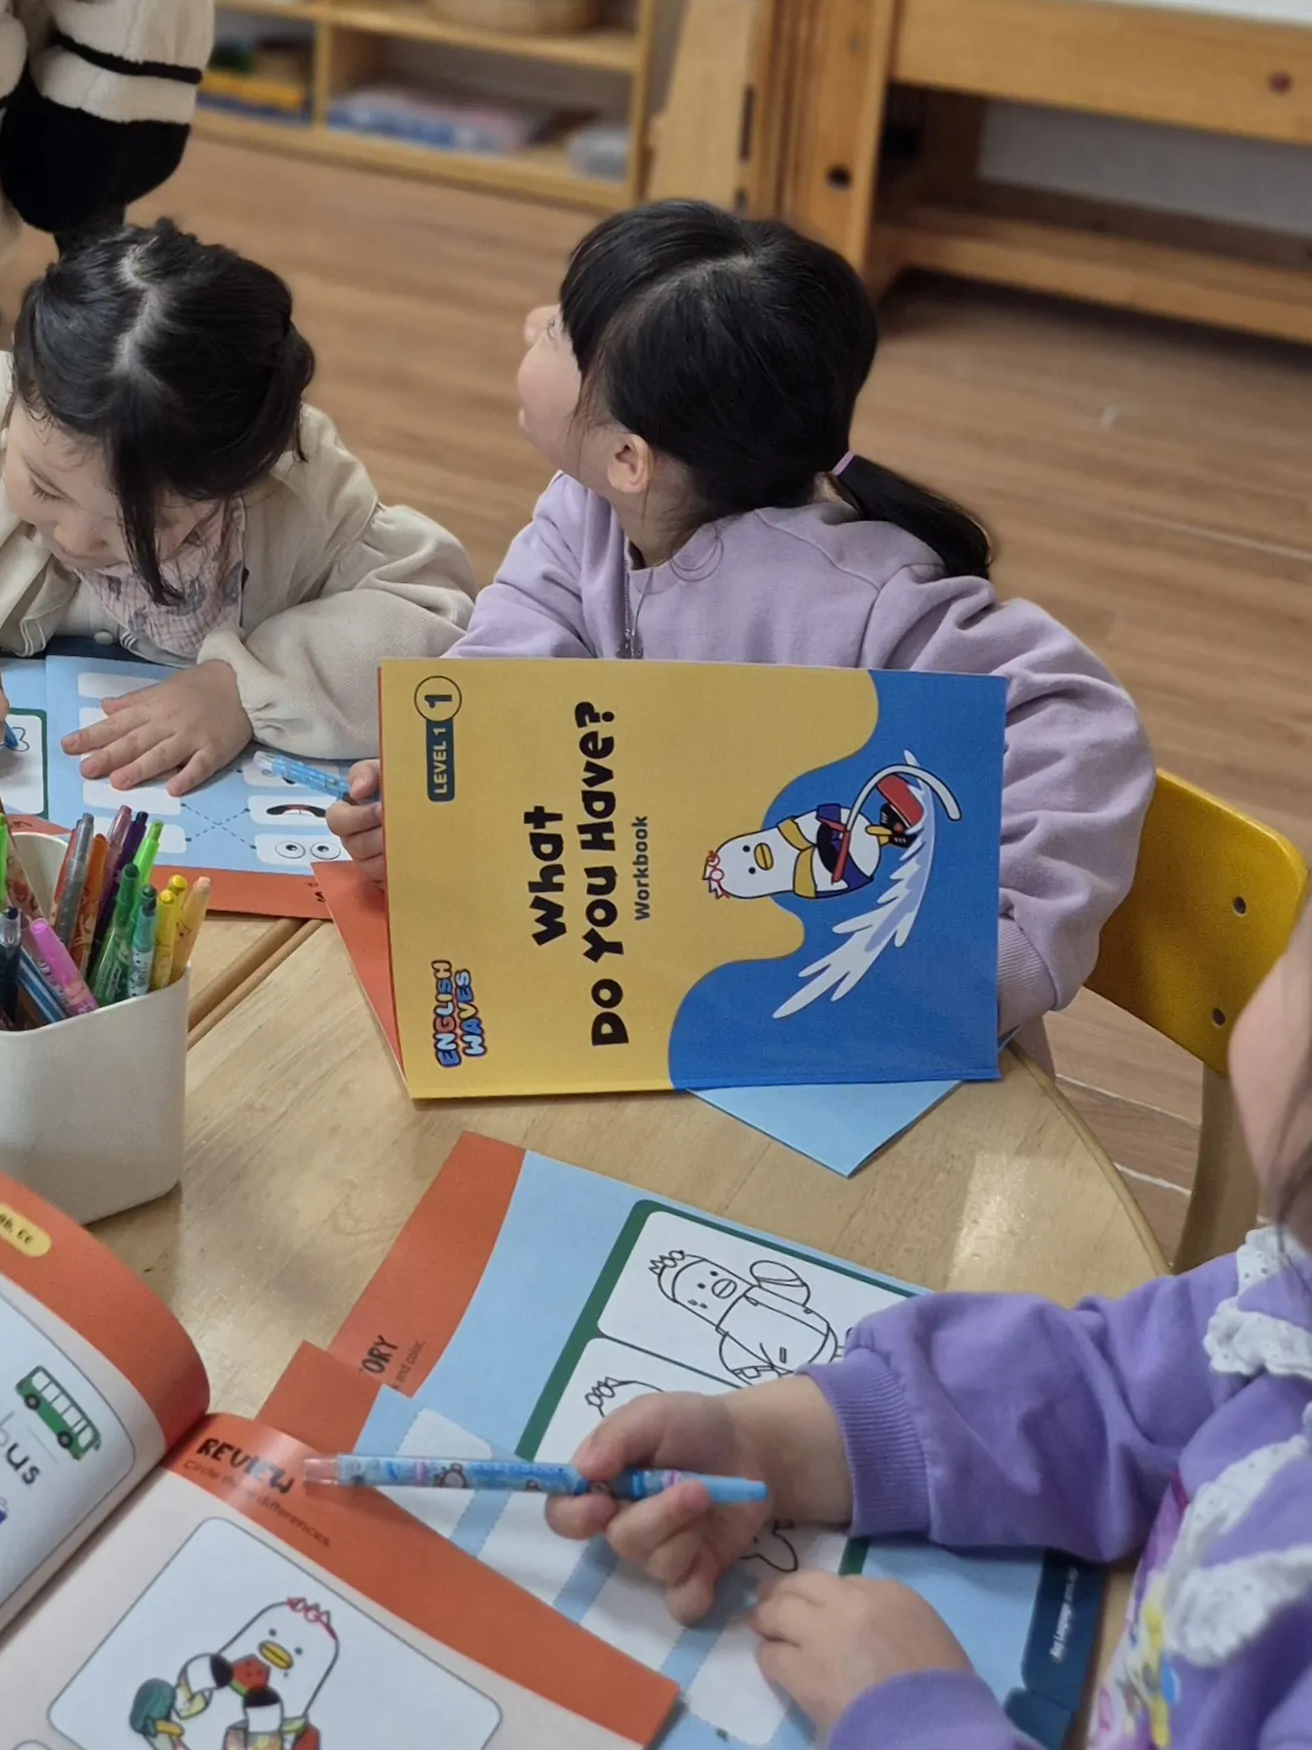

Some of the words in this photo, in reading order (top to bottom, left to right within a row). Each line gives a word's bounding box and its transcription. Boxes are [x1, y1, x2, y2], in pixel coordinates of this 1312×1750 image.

[424, 691, 454, 708] 1
[434, 727, 447, 737] 1
[433, 739, 448, 795] LEVEL
[574, 701, 616, 853] Have?
[524, 804, 567, 947] What
[633, 815, 651, 921] Workbook
[583, 865, 624, 964] You
[431, 960, 462, 1067] ENGLISH
[453, 969, 488, 1058] WAVES
[590, 978, 630, 1047] Do
[359, 1334, 398, 1374] ORY
[196, 1438, 295, 1494] REVIEW
